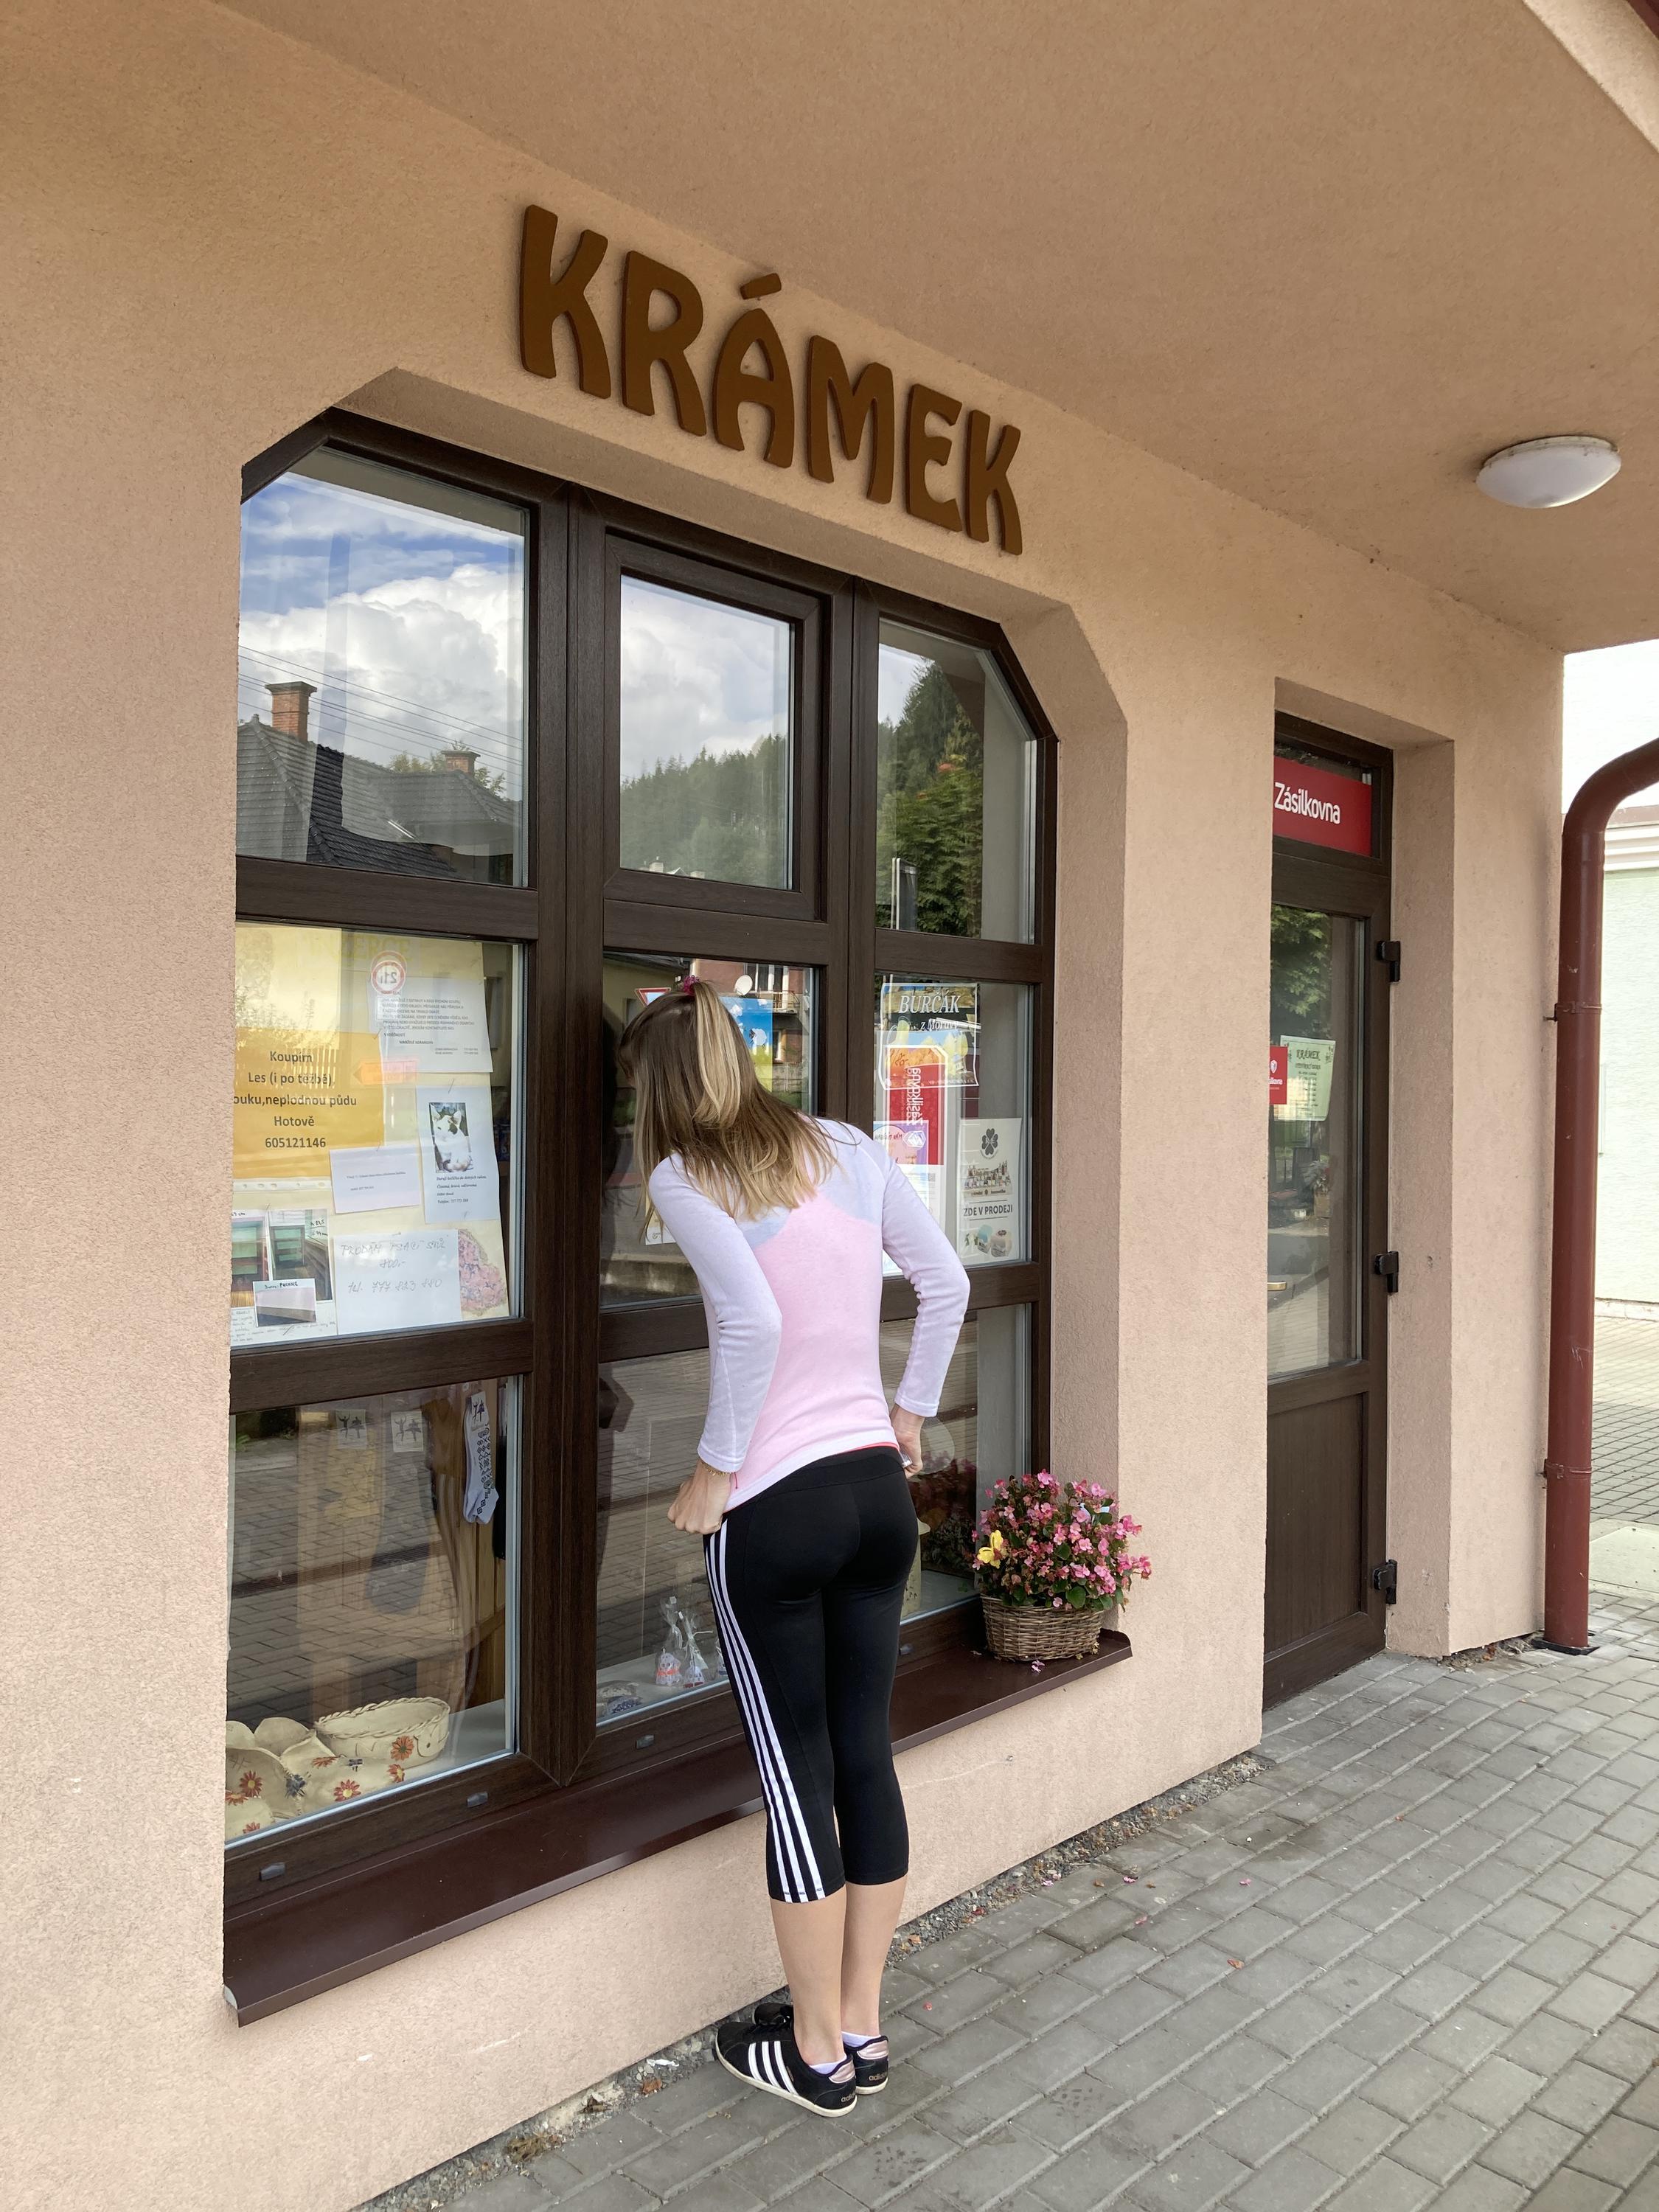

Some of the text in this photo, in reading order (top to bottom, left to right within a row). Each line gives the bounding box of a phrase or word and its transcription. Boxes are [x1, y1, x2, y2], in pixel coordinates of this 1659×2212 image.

[519, 204, 1023, 555] KRÁMEK
[1274, 782, 1340, 824] Zásilkovna
[899, 990, 961, 1014] BURČÁK
[270, 1051, 313, 1064] Koupím
[248, 1072, 266, 1083] Les
[270, 1072, 277, 1085] (i
[280, 1075, 294, 1086] po
[330, 1094, 357, 1107] půdu
[274, 1116, 315, 1127] Hotově
[265, 1137, 326, 1148] 605121146
[964, 1204, 1013, 1217] ZDE V PRODEJI
